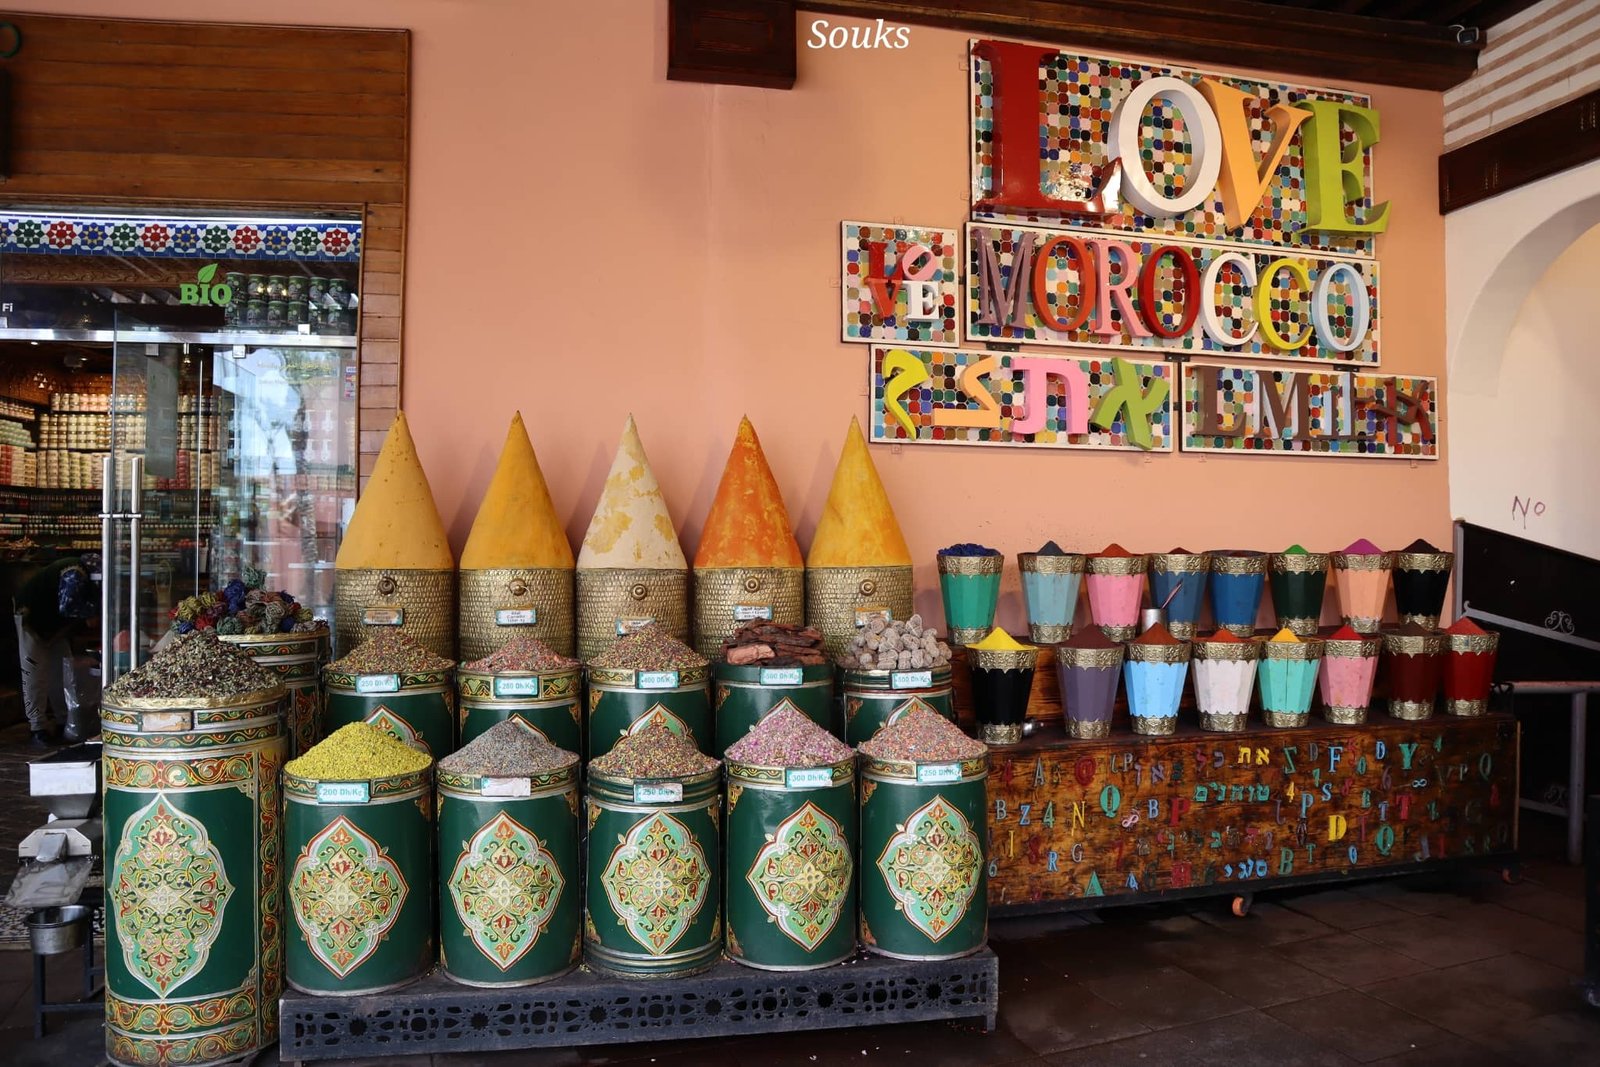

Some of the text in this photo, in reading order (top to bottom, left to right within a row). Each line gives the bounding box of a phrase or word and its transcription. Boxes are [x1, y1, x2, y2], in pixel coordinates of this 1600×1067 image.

[972, 40, 1389, 236] LOVE
[180, 284, 232, 305] BIO
[976, 228, 1371, 353] MOROCCO
